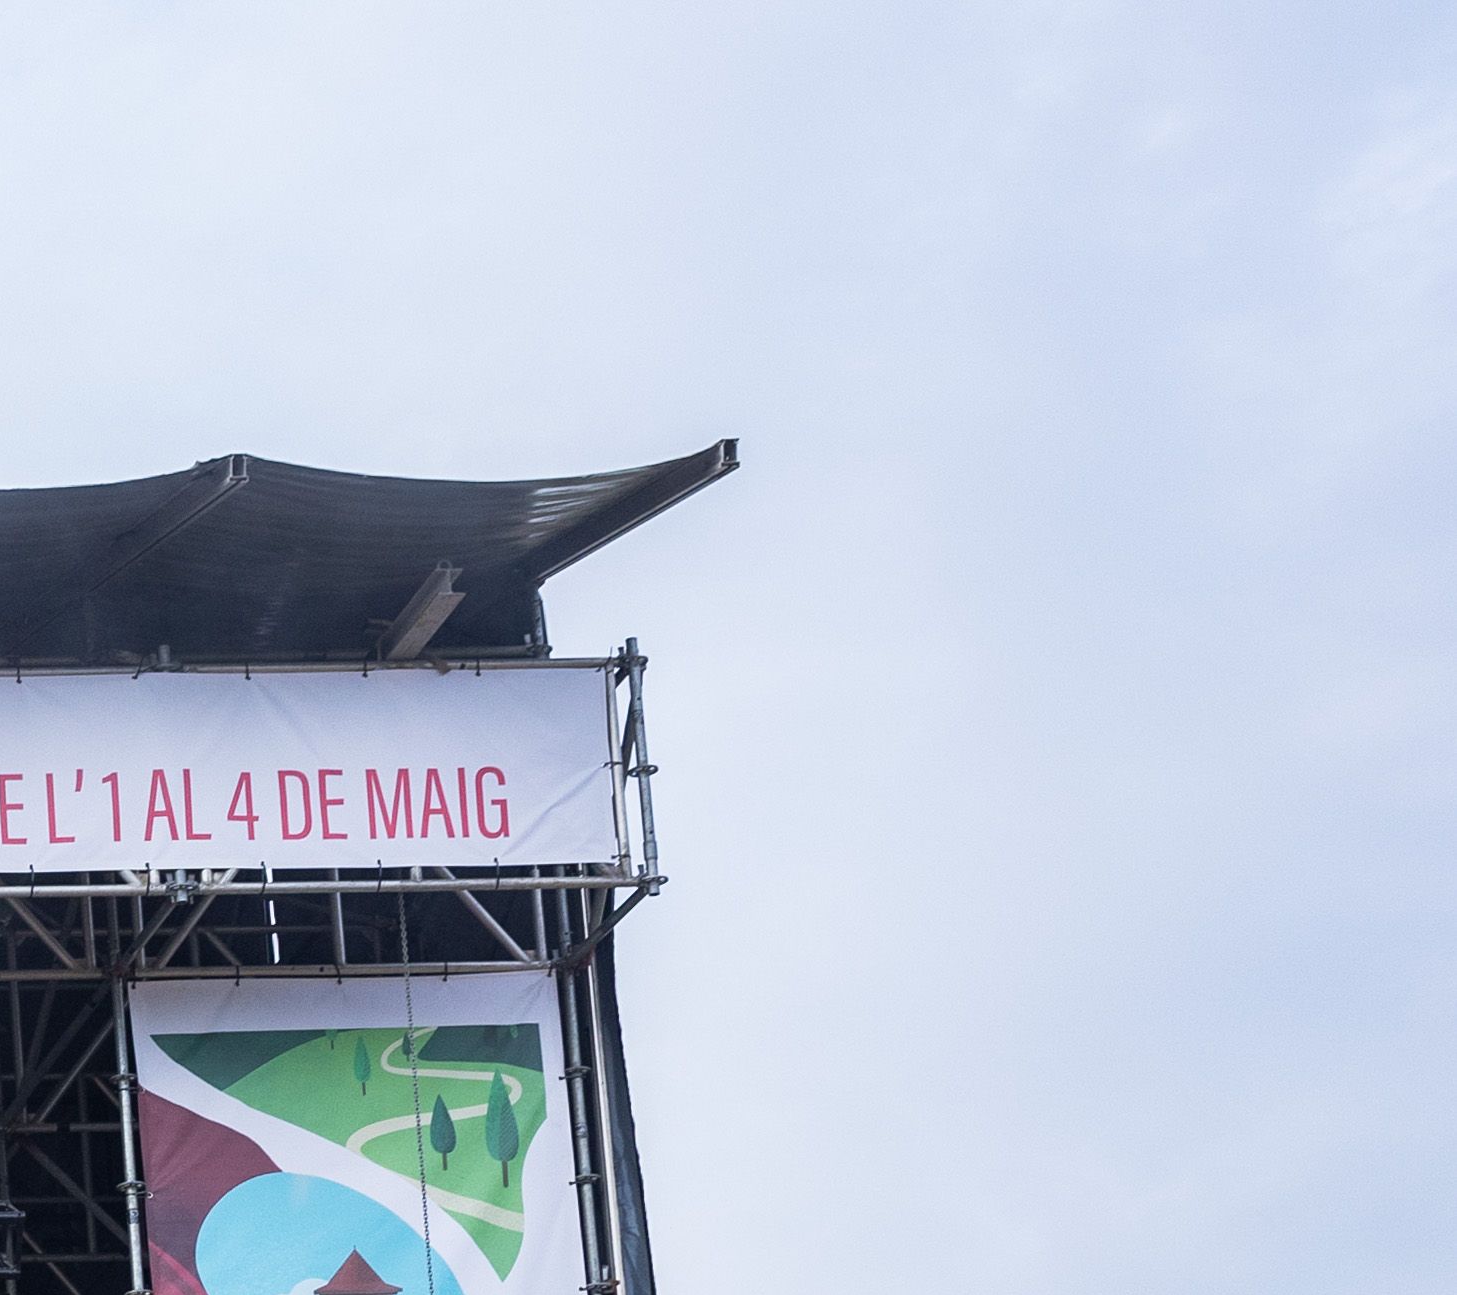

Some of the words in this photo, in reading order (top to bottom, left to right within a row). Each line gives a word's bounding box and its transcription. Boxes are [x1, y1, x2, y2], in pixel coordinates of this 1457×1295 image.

[144, 768, 212, 842] AL
[227, 771, 260, 841] 4
[278, 768, 348, 841] DE
[366, 766, 511, 840] MAIG
